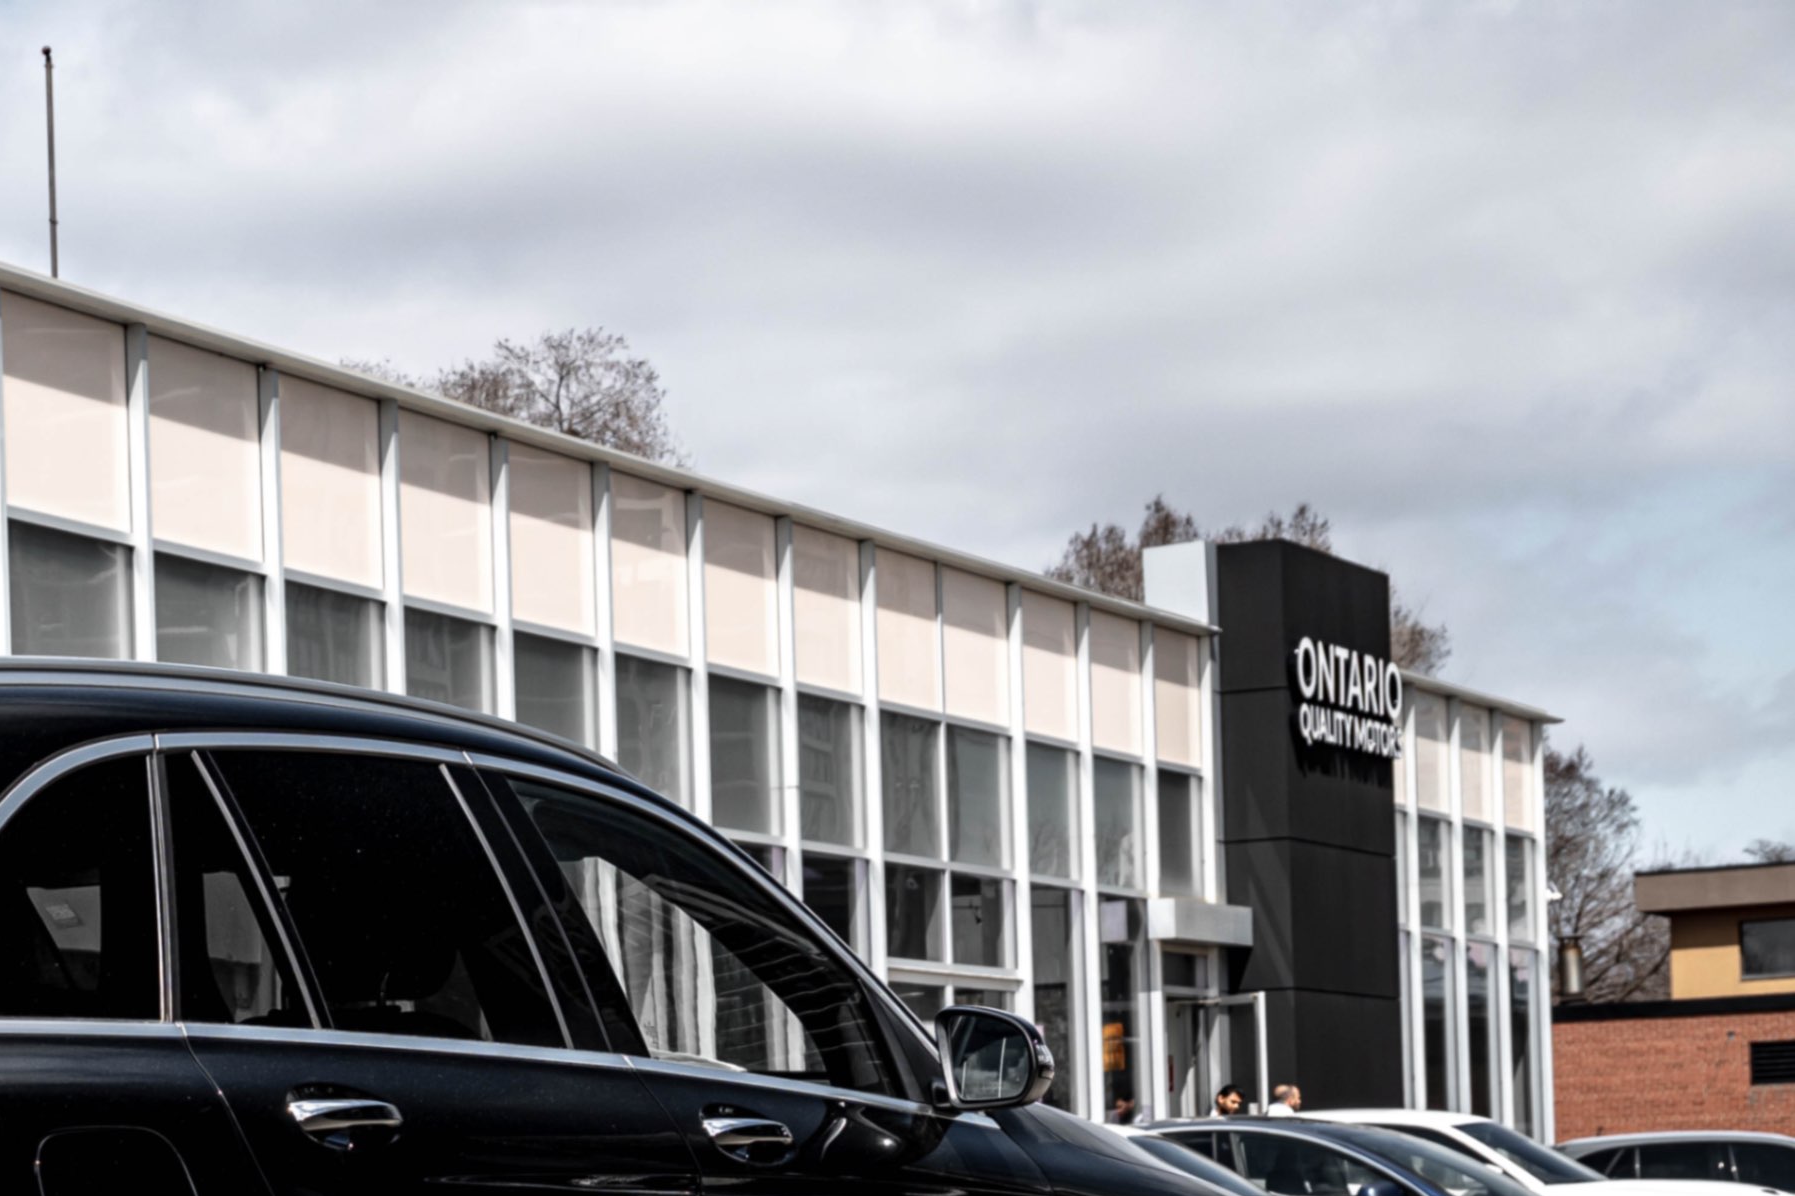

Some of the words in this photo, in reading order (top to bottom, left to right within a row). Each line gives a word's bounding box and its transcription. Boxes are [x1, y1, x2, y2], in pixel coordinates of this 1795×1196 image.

[1296, 636, 1403, 719] ONTARIO
[1299, 702, 1354, 748] QUALITY
[1354, 715, 1403, 758] MOTORS
